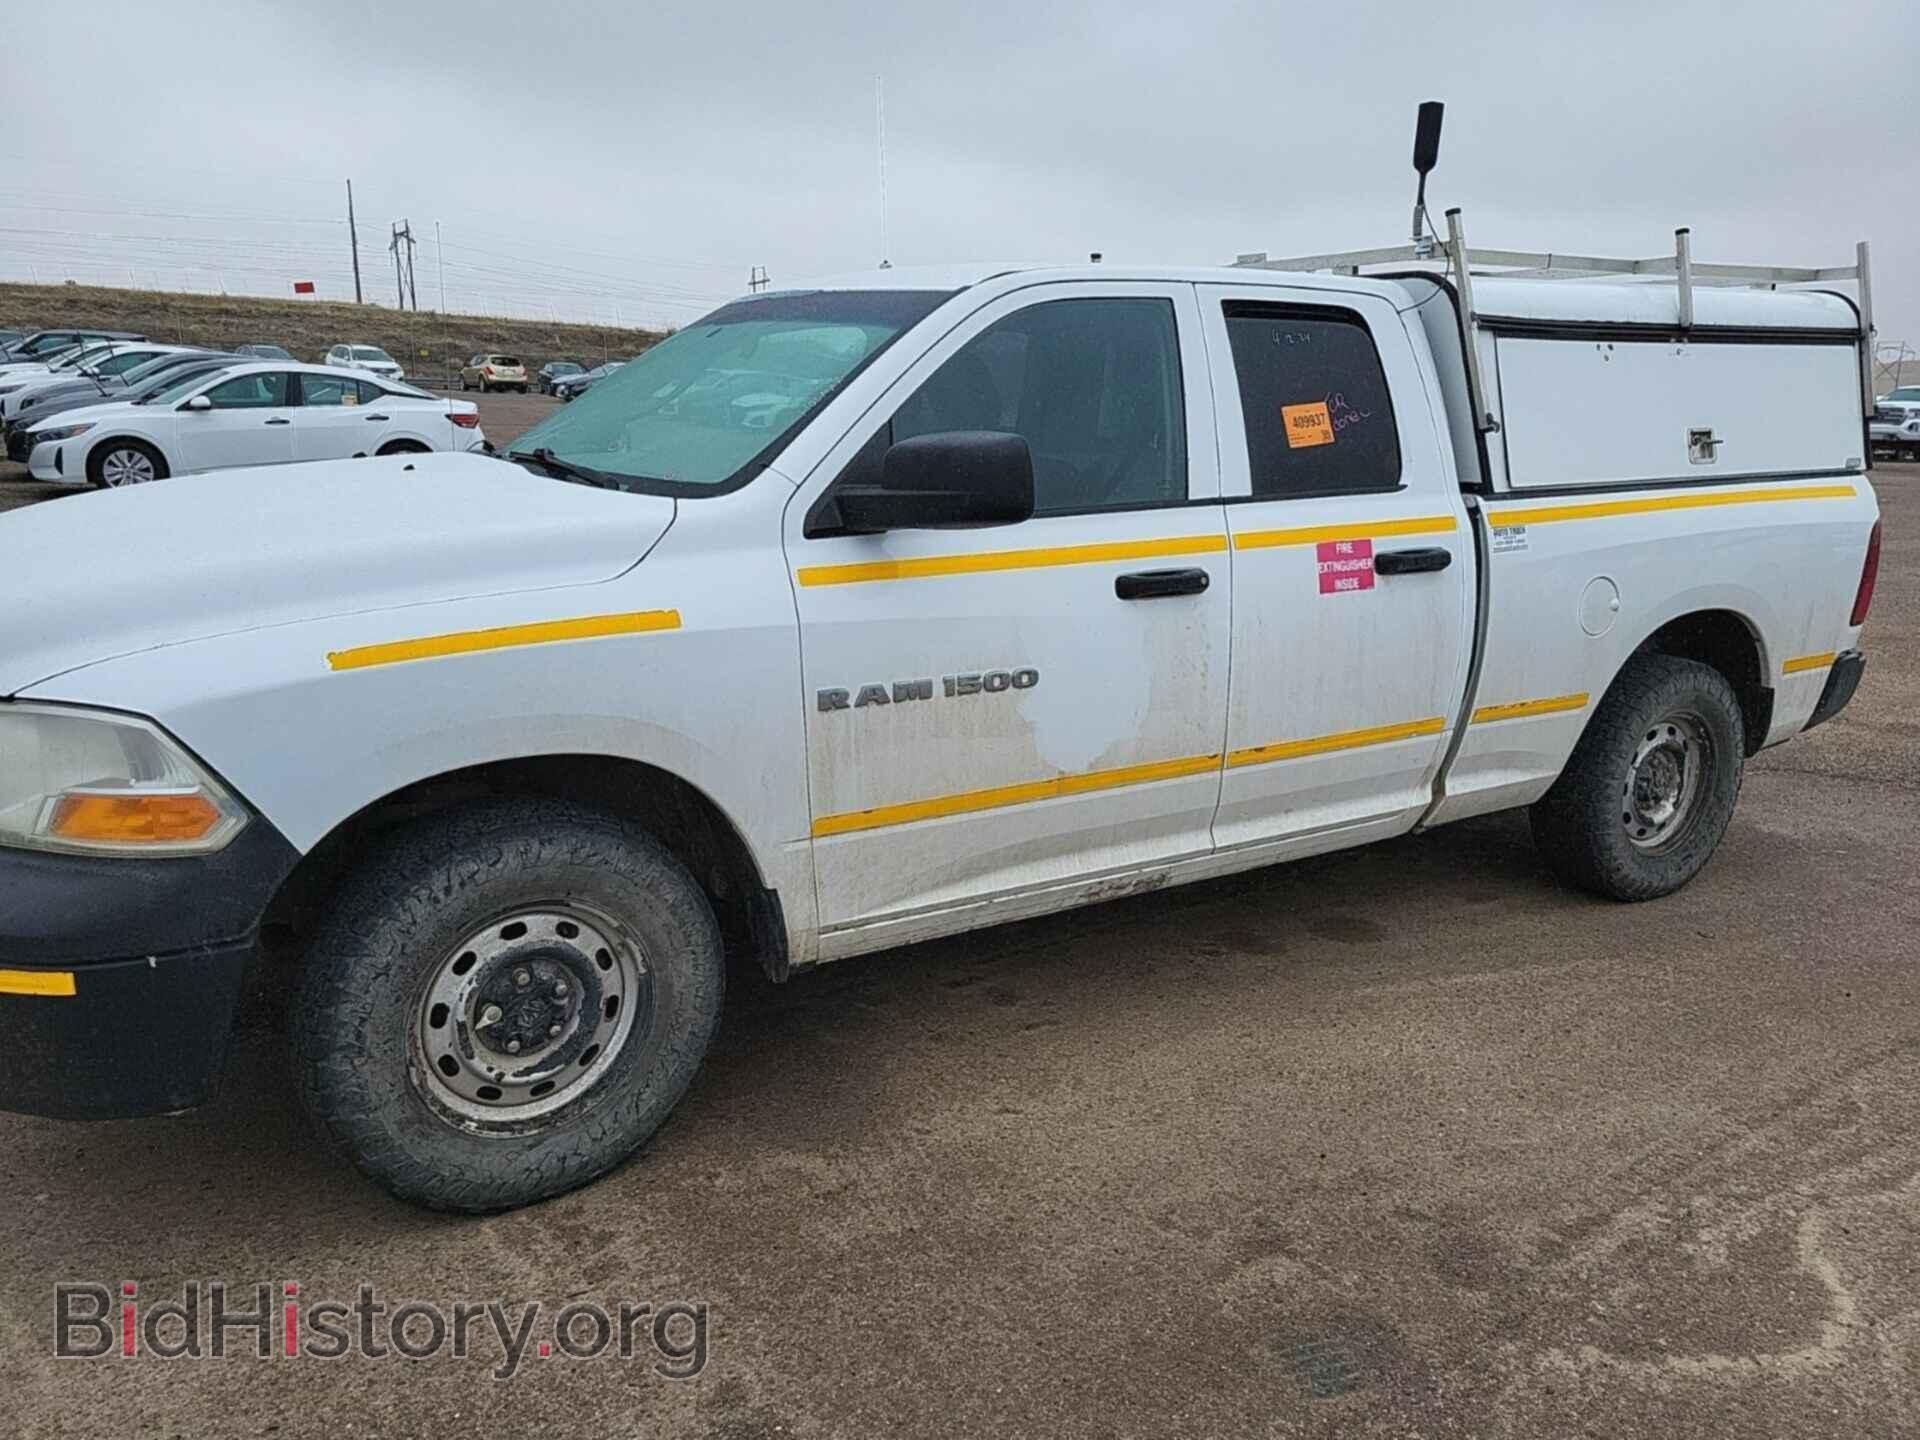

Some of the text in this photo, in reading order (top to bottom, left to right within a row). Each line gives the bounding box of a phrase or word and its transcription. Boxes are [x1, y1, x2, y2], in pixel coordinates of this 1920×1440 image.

[1293, 412, 1325, 430] 409937
[1336, 542, 1354, 555] FIRE
[817, 667, 1039, 712] RAM 1500
